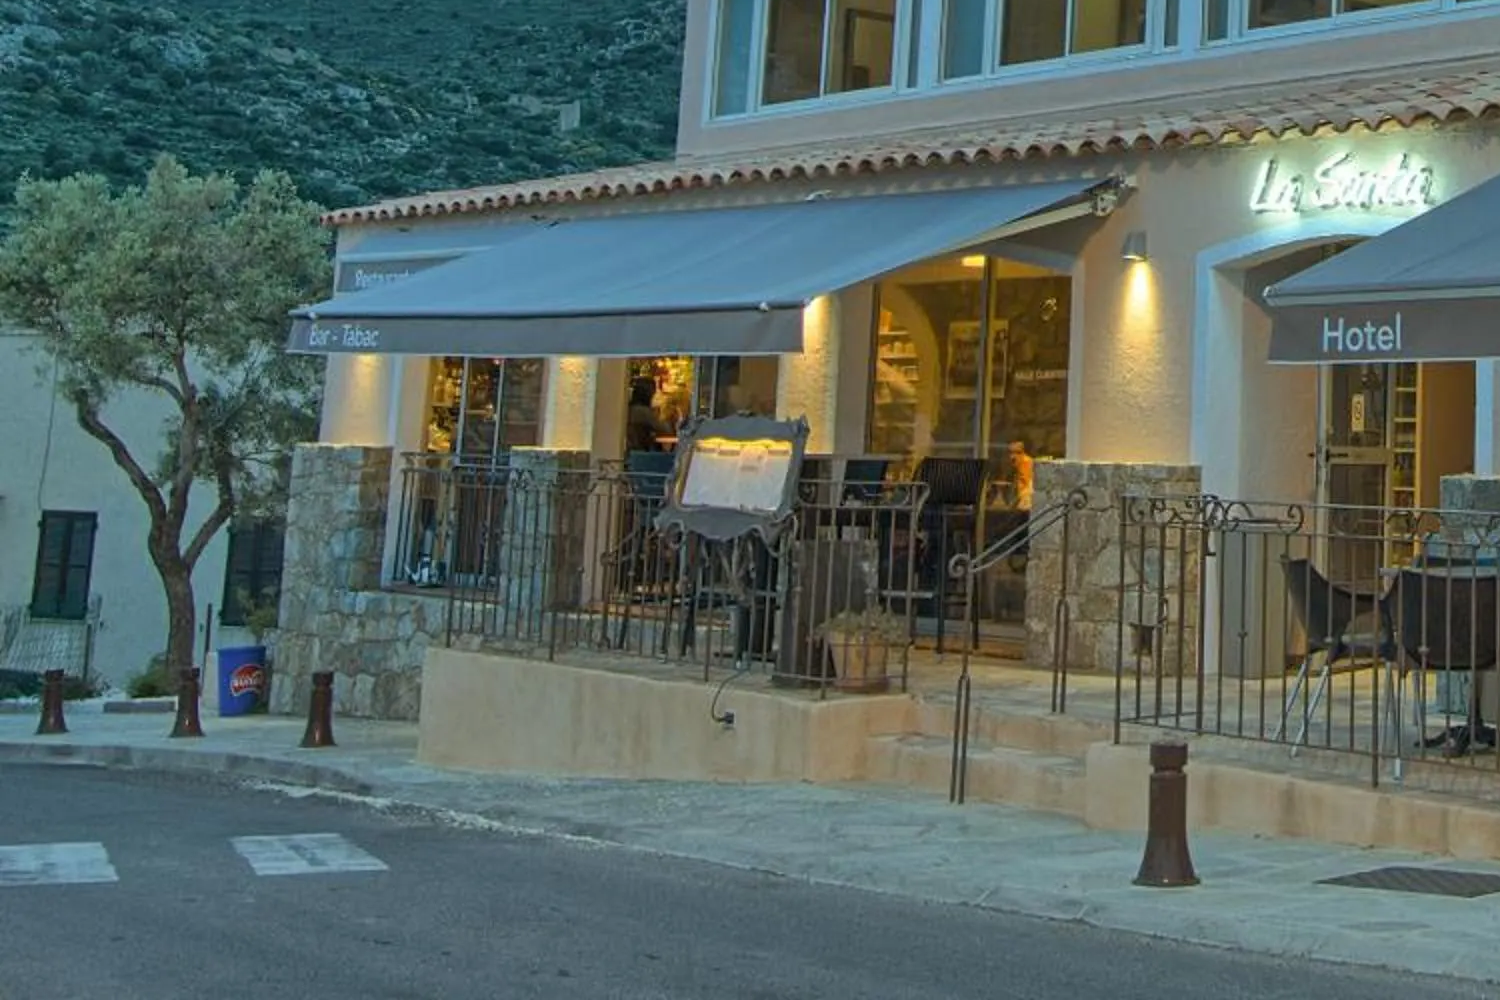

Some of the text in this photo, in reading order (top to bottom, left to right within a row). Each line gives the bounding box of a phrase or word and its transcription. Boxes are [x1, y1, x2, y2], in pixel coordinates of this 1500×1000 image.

[1250, 151, 1435, 213] La Santa
[309, 323, 330, 345] Bar
[342, 324, 380, 347] Tabac
[1323, 312, 1402, 353] Hotel
